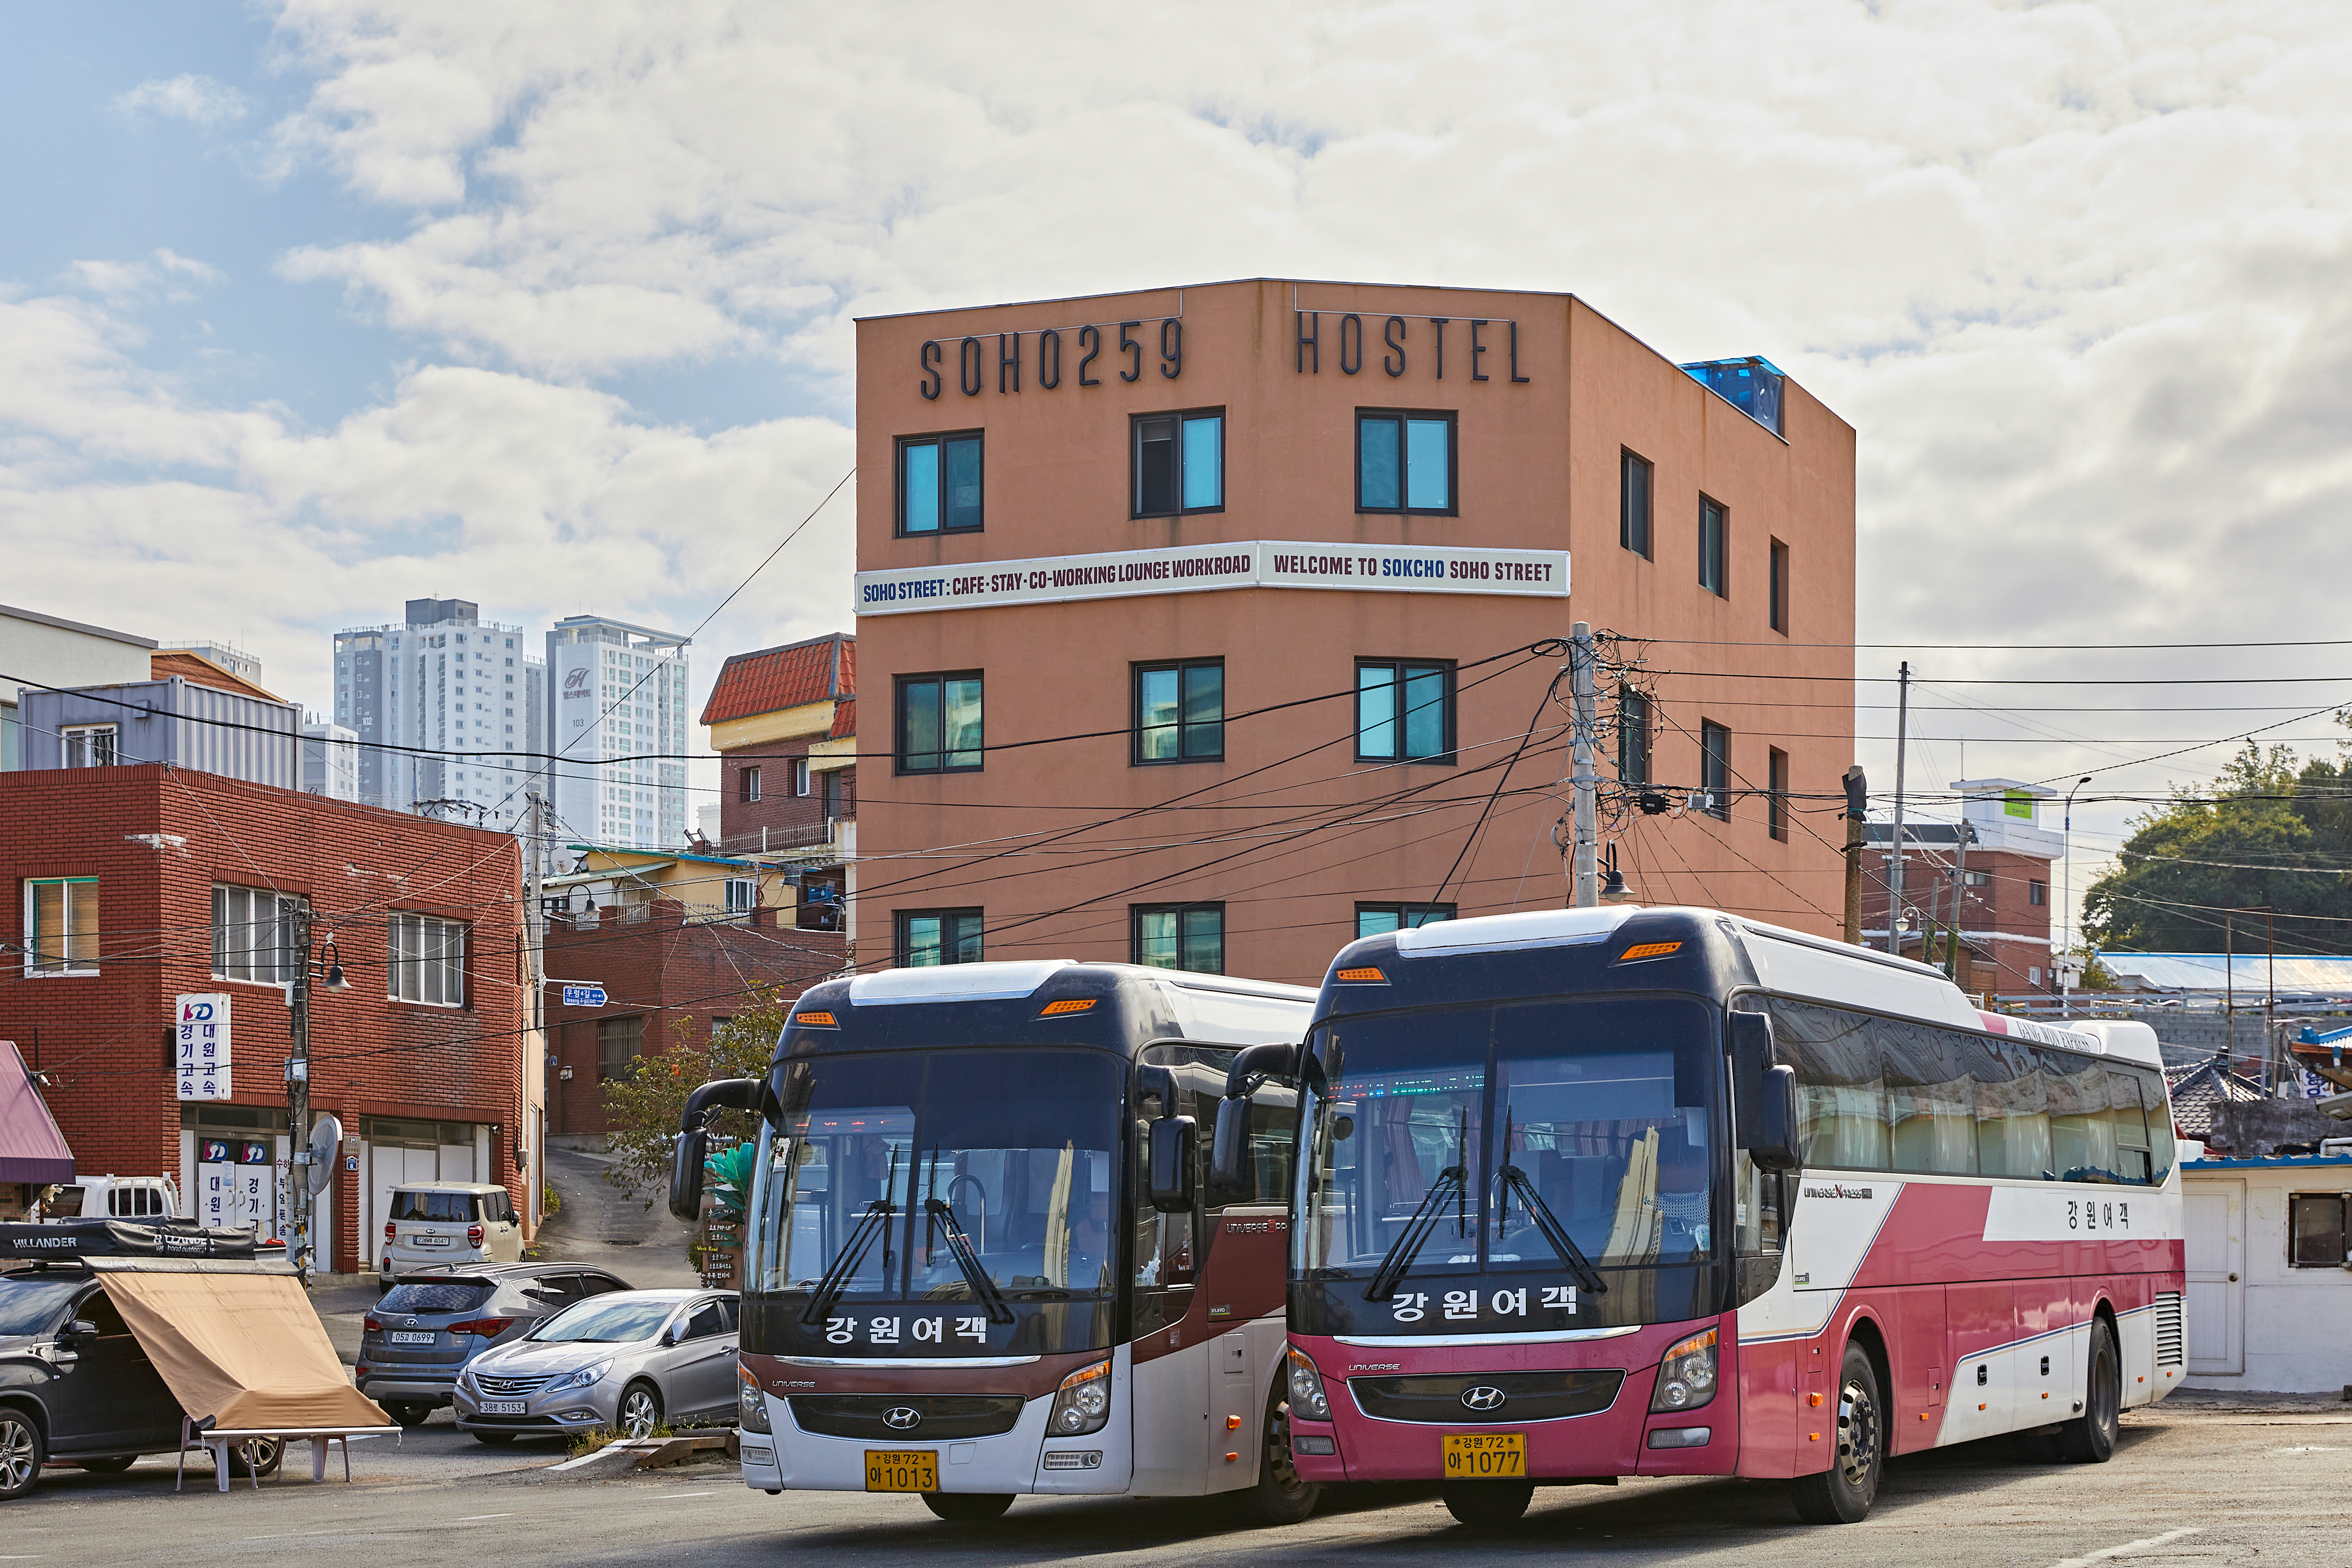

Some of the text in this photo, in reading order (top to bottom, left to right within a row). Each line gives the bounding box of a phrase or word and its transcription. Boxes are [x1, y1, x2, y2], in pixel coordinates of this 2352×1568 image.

[920, 311, 1530, 400] SOHO259 HOSTEL
[864, 583, 896, 603] SOHO
[1119, 561, 1169, 582] LOUNGE
[1172, 555, 1250, 578] WORKROAD
[1274, 555, 1551, 581] WELCOME TO SOKCHO SOHO STREET
[563, 689, 591, 700] 힐스테이트
[362, 717, 373, 725] 102
[573, 719, 584, 727] 103
[2017, 1021, 2090, 1051] GANG WON EXPRESS
[181, 1024, 193, 1095] 경기고속
[203, 1024, 215, 1095] 대원고속
[2068, 1200, 2128, 1229] 강원여객
[13, 1237, 77, 1248] HILLANDER
[1392, 1286, 1577, 1322] 강원여객
[412, 1333, 431, 1342] 0699
[826, 1317, 986, 1344] 강원여객
[484, 1403, 521, 1412] 38로 5153
